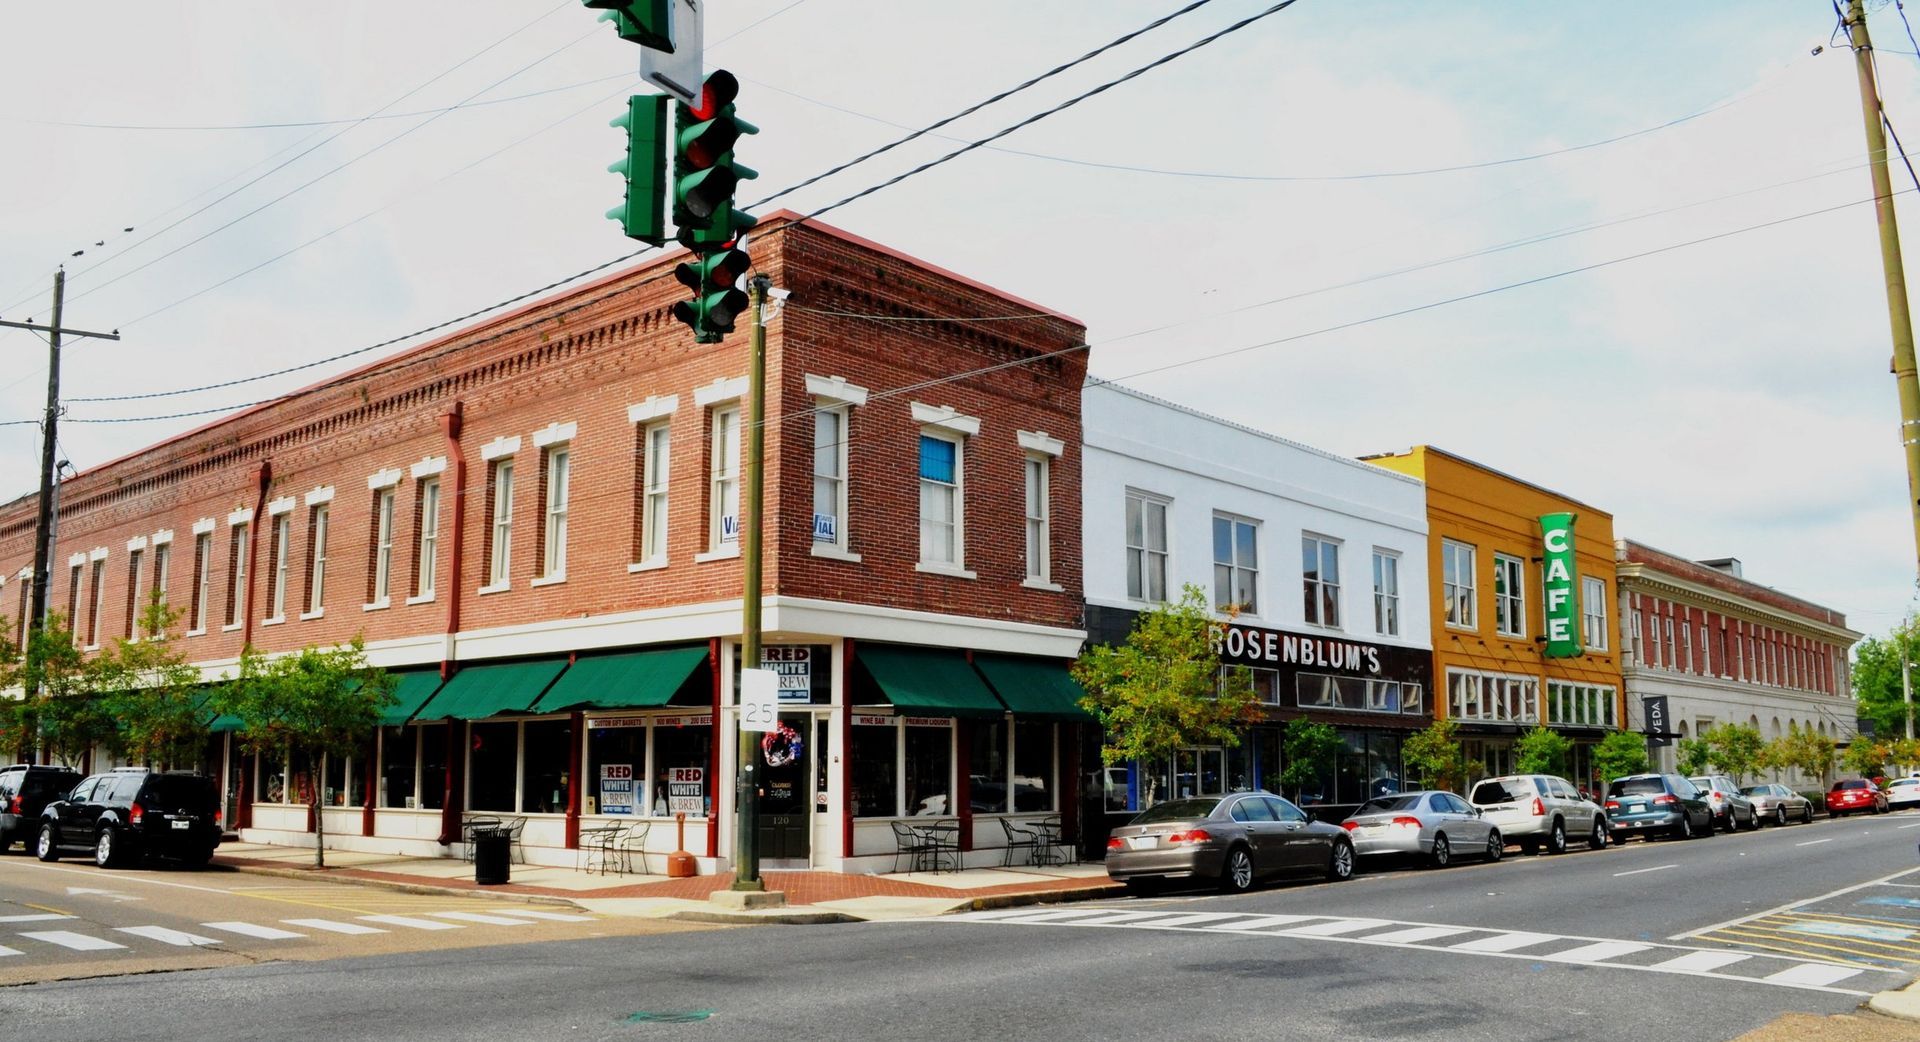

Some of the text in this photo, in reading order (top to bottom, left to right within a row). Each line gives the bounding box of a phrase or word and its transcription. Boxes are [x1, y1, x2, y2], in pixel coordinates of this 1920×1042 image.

[724, 516, 739, 534] VIA
[1544, 529, 1570, 641] CAFE
[767, 648, 809, 661] RED
[1208, 625, 1381, 673] ROSENBLUM'S
[760, 662, 806, 674] WHITE
[777, 676, 808, 688] REW
[746, 703, 772, 723] 25
[860, 716, 874, 724] WINE
[607, 766, 631, 778] RED
[676, 768, 702, 781] RED
[603, 780, 630, 791] WHITE
[671, 784, 700, 796] WHITE
[603, 793, 632, 804] & BREW
[670, 798, 702, 810] & BREW
[773, 816, 789, 824] 120
